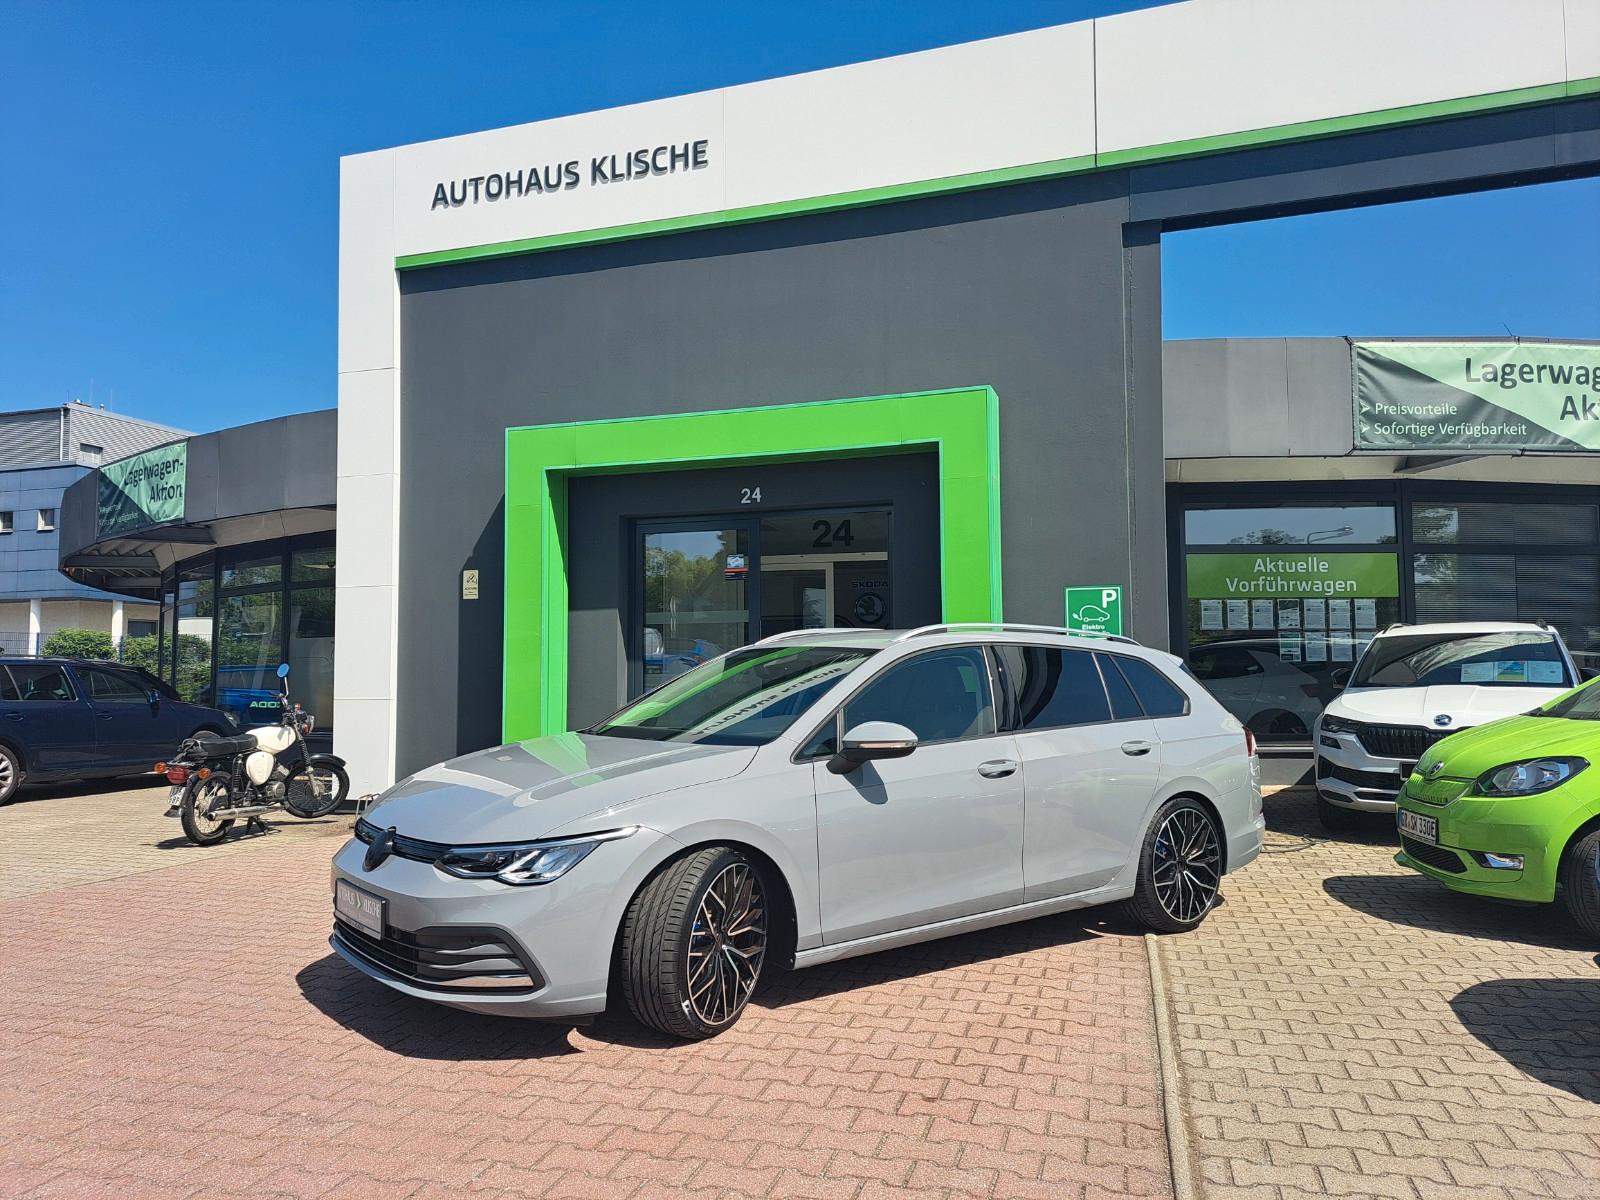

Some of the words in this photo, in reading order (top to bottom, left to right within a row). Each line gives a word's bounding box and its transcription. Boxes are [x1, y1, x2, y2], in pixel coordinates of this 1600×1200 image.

[431, 160, 580, 210] AUTOHAUS
[590, 139, 709, 186] KLISCHE
[1375, 402, 1457, 415] Preisvorteile
[1560, 394, 1600, 421] Ak
[1374, 422, 1435, 437] Sofortige
[1439, 422, 1527, 437] Verfügbarkeit
[149, 481, 182, 504] Aktion
[740, 487, 762, 504] 24
[811, 519, 854, 548] 24
[1253, 557, 1329, 573] Aktuelle
[1225, 575, 1357, 596] Vorführwagen
[1101, 589, 1118, 609] P
